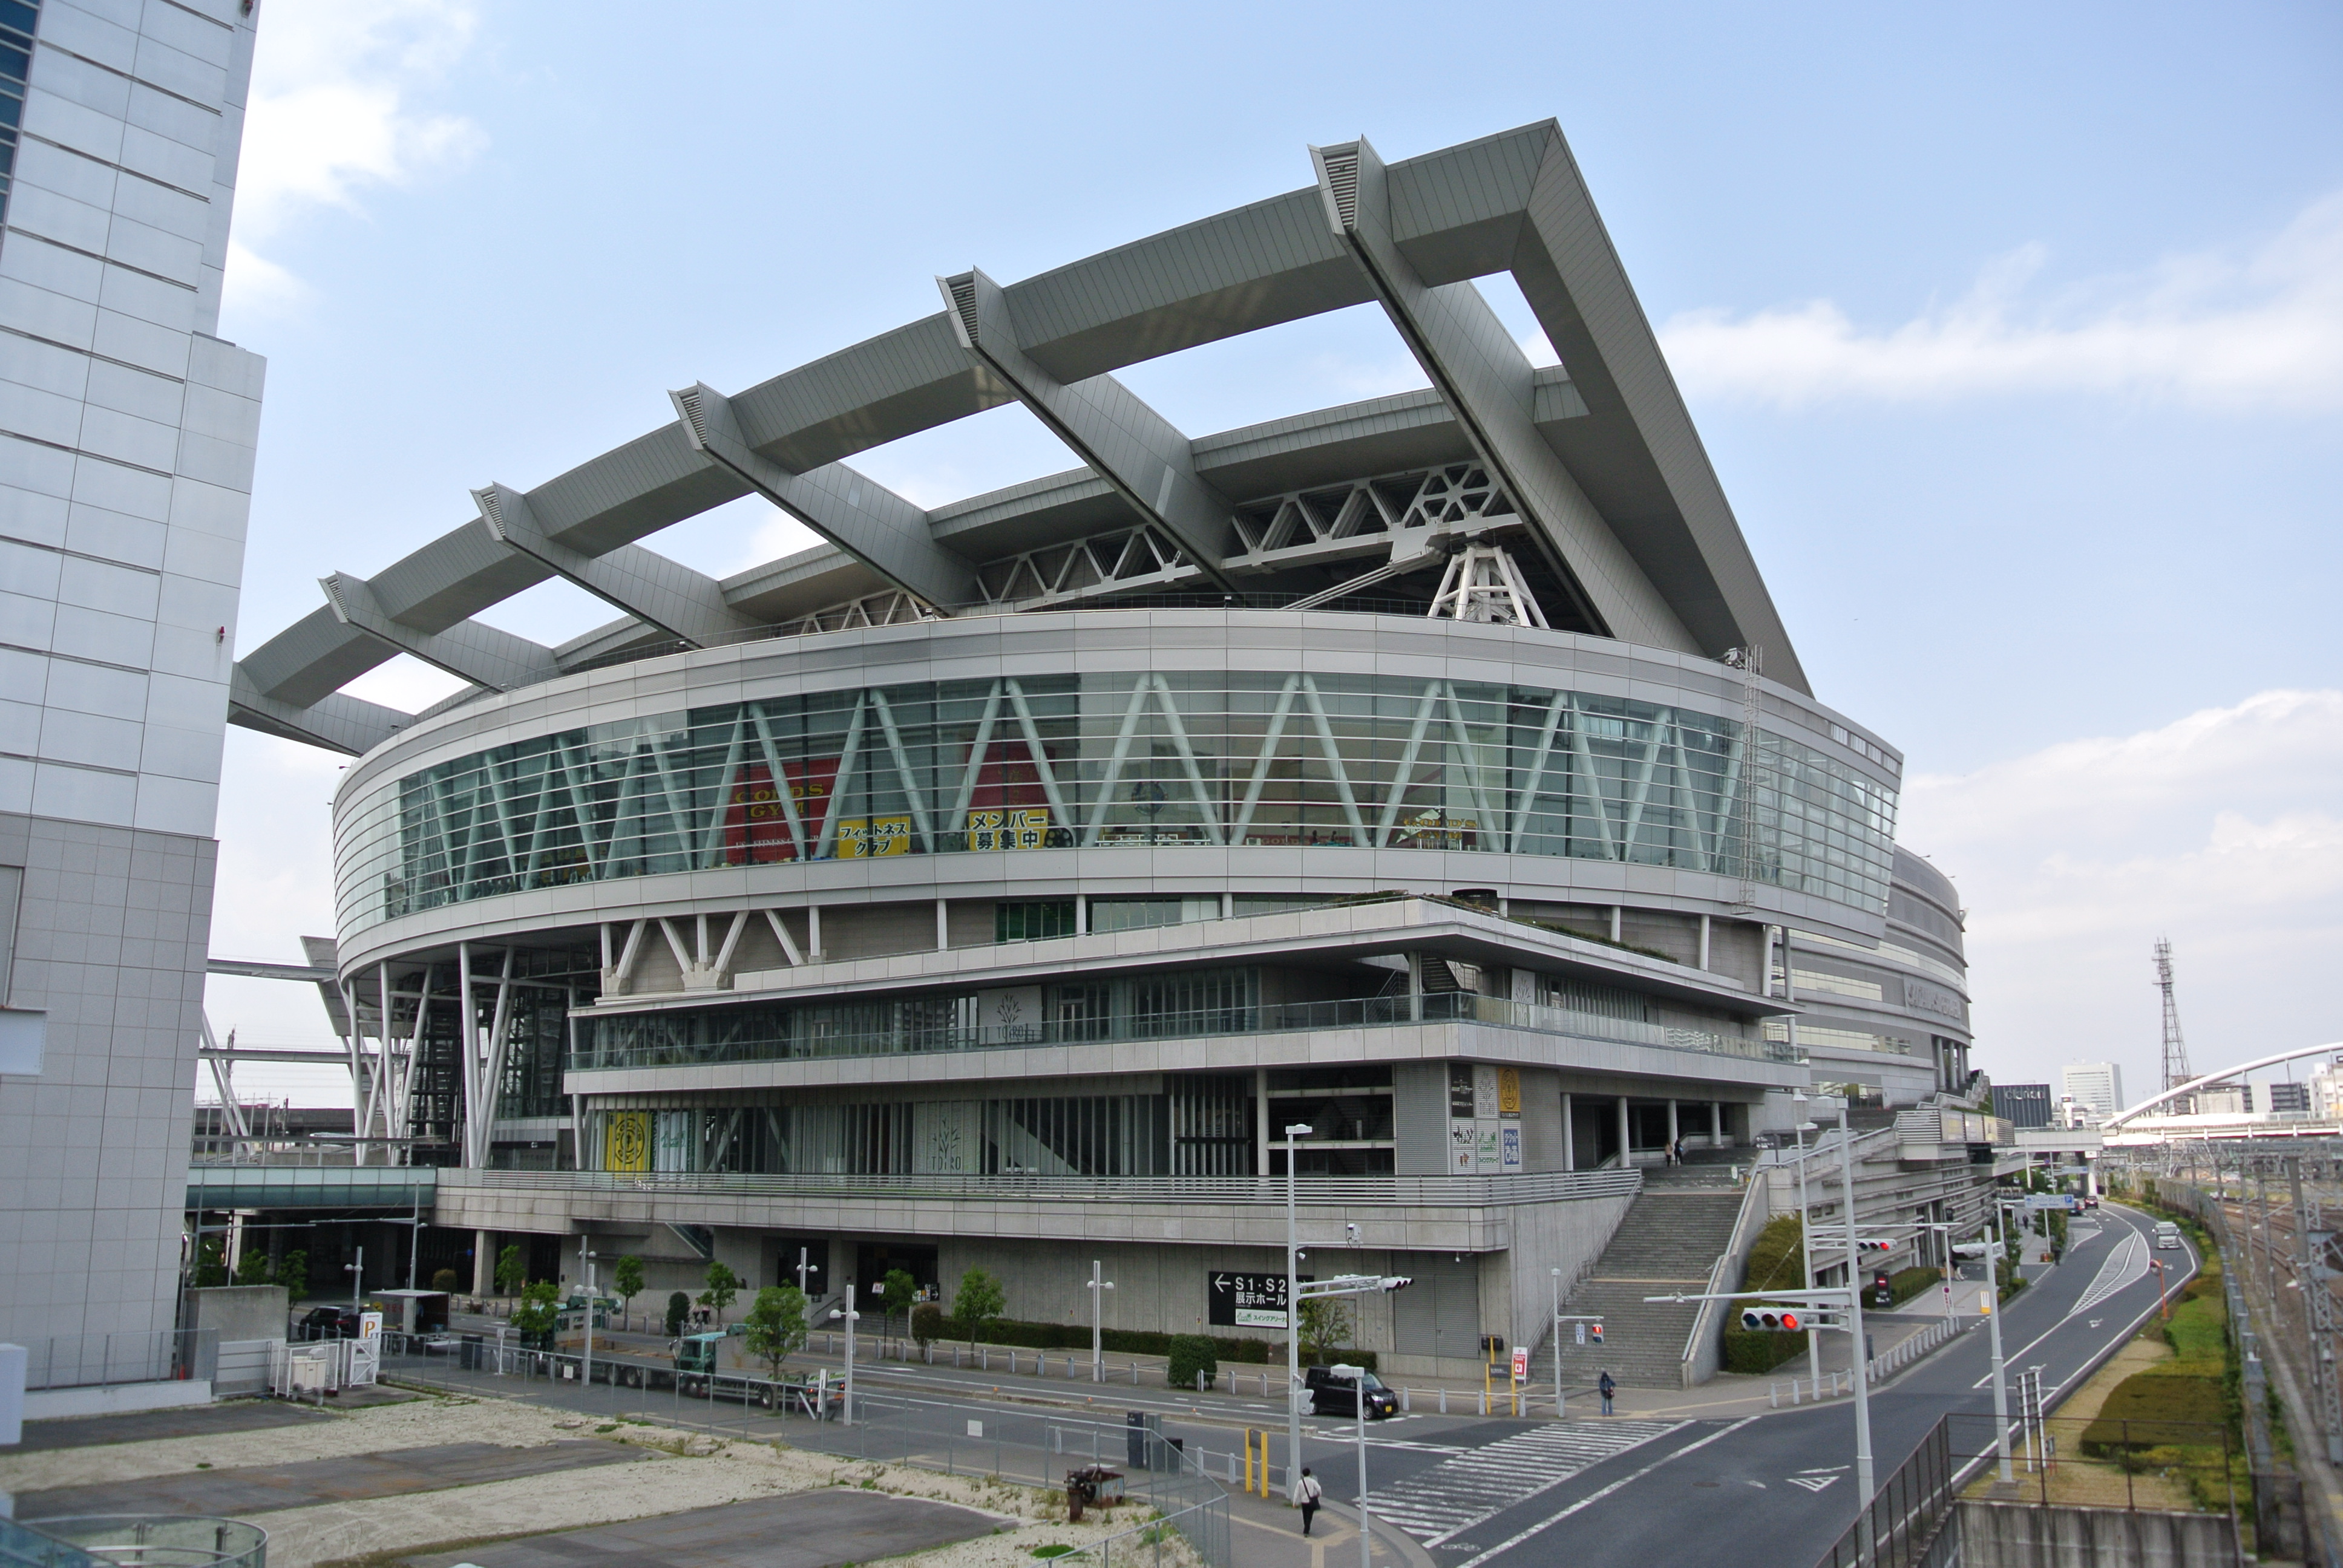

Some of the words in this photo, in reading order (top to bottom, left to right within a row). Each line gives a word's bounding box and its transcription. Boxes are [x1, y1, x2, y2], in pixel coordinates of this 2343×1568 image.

[972, 811, 1046, 831] メンバー
[841, 823, 908, 840] フィットネス
[976, 829, 1039, 850] 募集中
[855, 839, 892, 856] クラブ
[1236, 1292, 1286, 1306] 展示ホール
[364, 1321, 376, 1338] P
